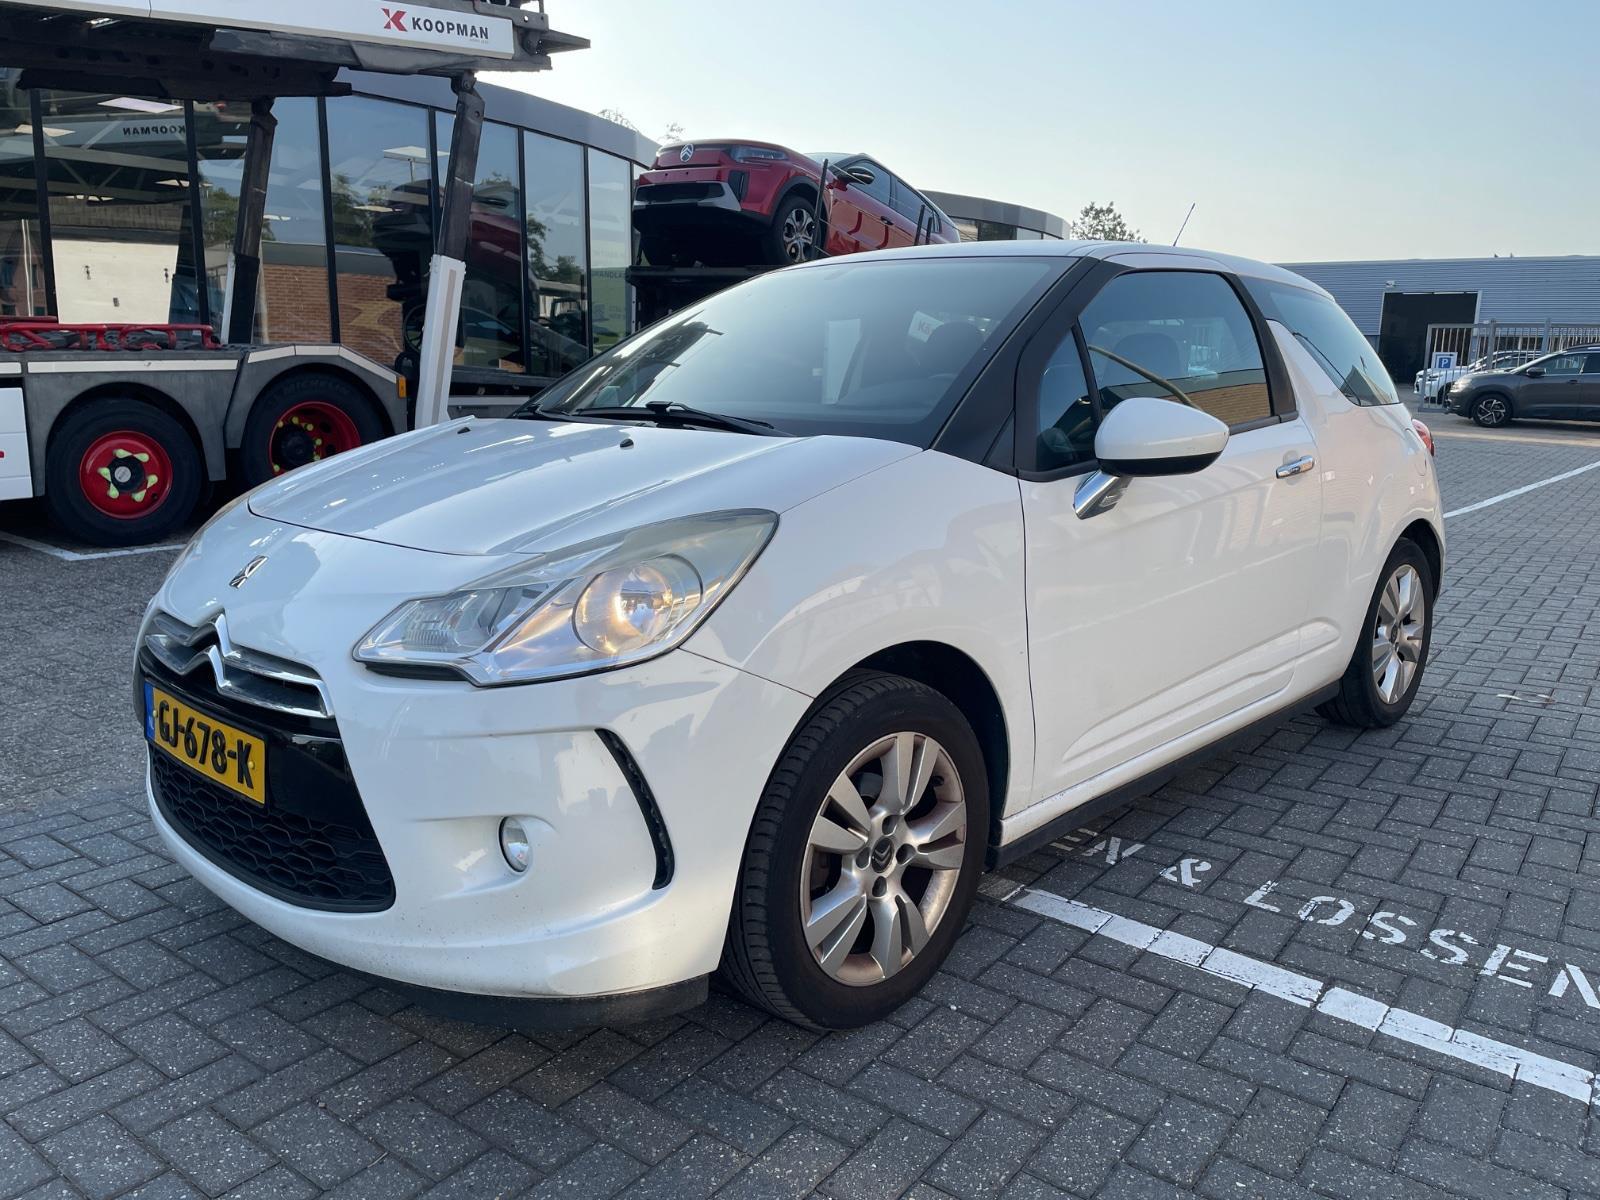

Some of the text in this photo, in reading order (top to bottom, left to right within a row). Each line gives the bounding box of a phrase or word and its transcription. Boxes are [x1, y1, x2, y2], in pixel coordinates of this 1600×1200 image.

[412, 16, 489, 40] KOOPMAN
[158, 700, 254, 789] GJ-678-K
[1243, 880, 1600, 1010] LOSSEN
